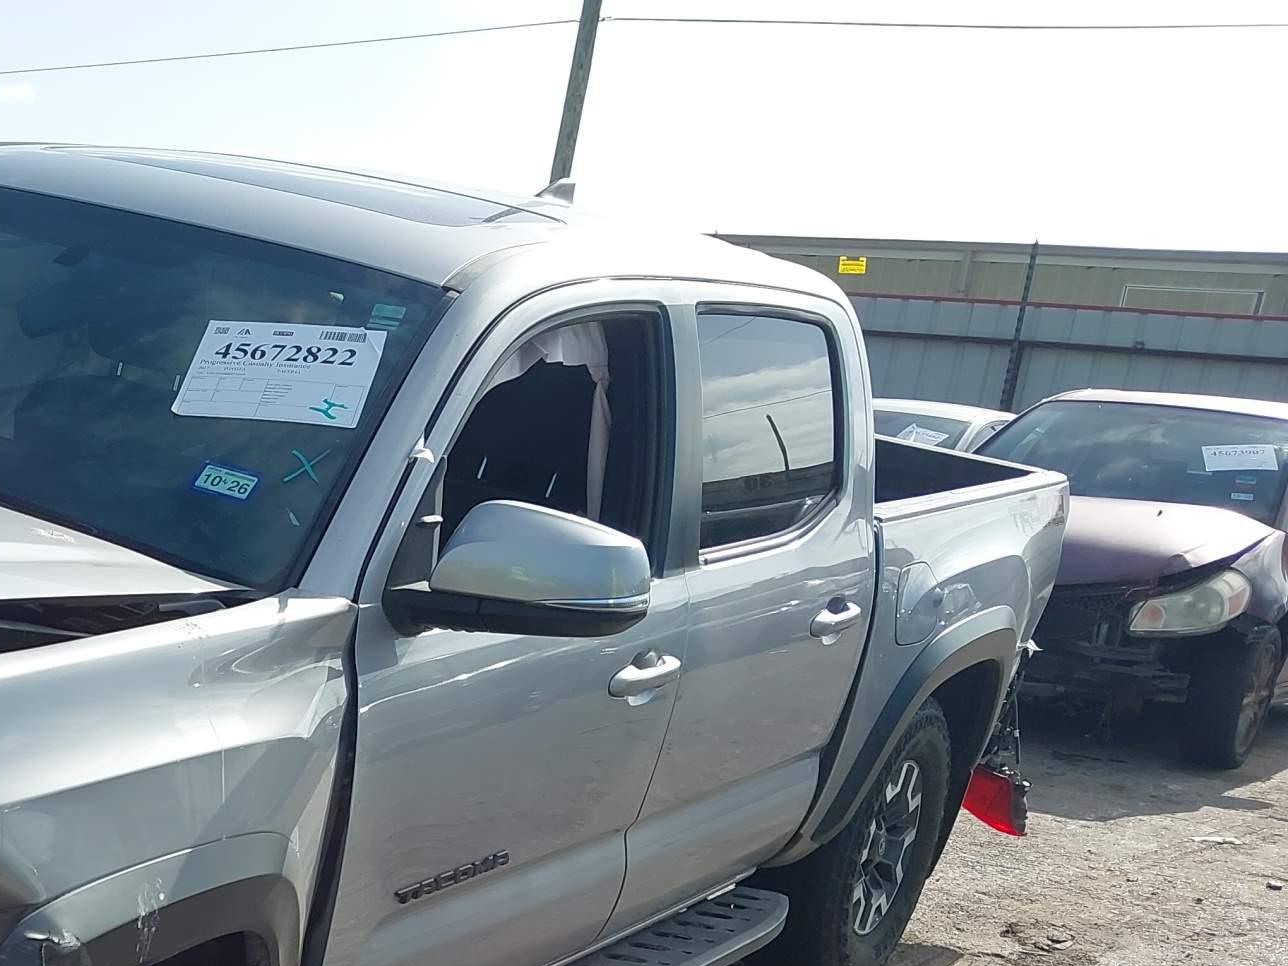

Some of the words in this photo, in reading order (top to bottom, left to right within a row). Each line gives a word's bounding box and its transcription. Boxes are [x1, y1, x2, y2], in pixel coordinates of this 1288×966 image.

[199, 359, 242, 368] Progressive
[215, 342, 357, 366] 45672822
[394, 849, 510, 904] TACOMA
